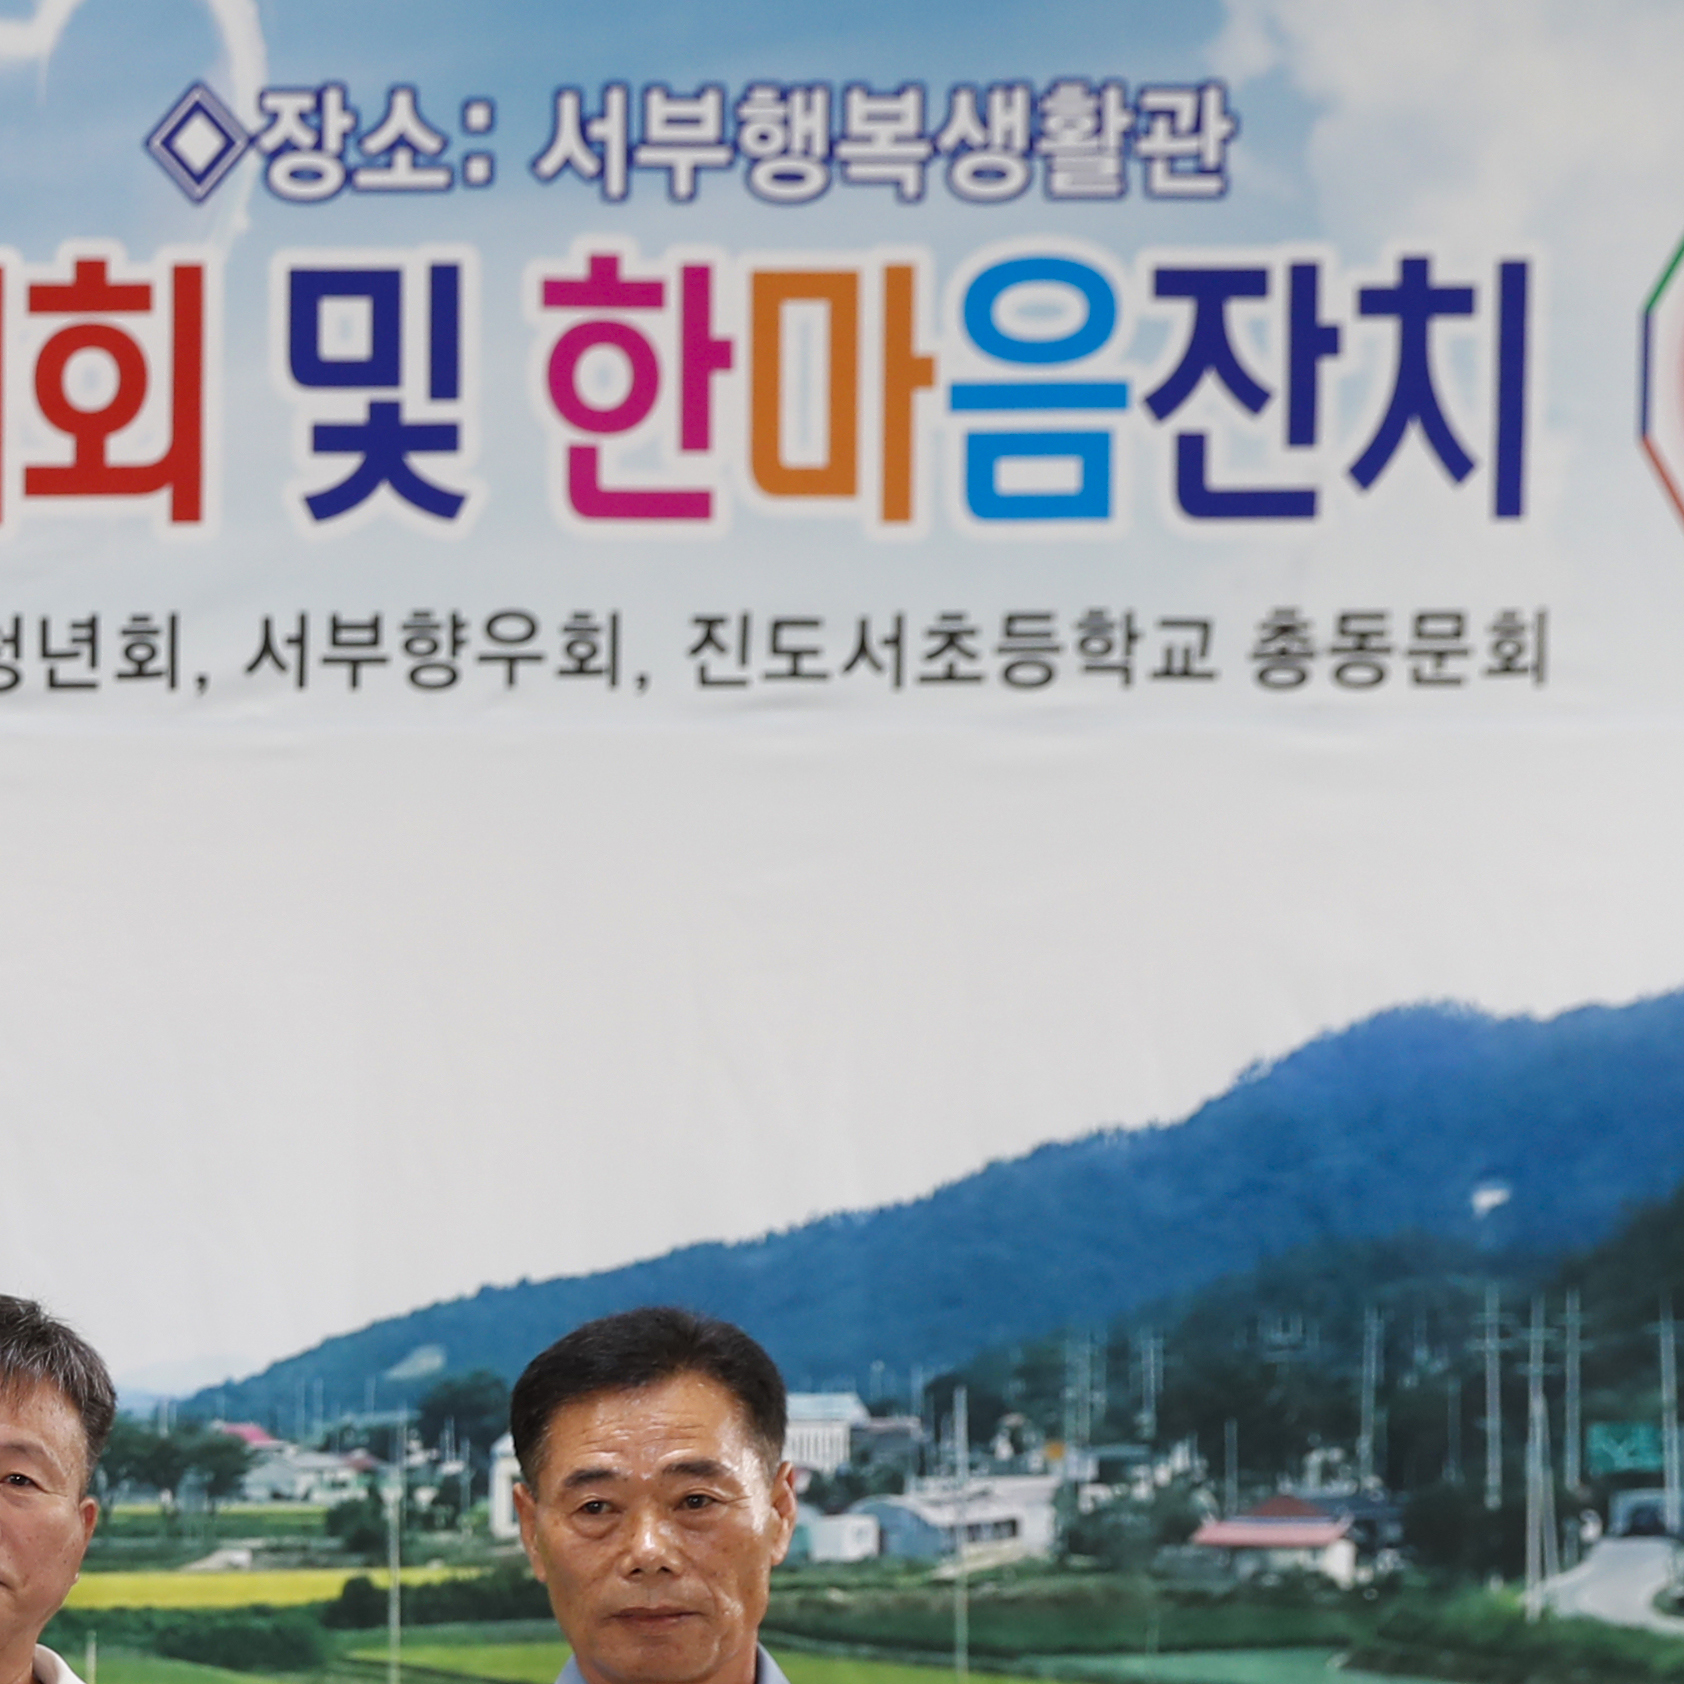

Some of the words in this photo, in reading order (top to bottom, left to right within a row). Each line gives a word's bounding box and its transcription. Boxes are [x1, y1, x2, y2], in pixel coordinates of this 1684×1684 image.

[253, 79, 495, 201] 장소:
[533, 78, 1237, 203] 서부행복생활관
[287, 262, 469, 523] 및
[542, 251, 1527, 525] 한마음잔치
[245, 609, 648, 695] 서부향우회,
[687, 607, 1220, 689] 진도서초등학교
[1250, 605, 1550, 690] 총동문회
